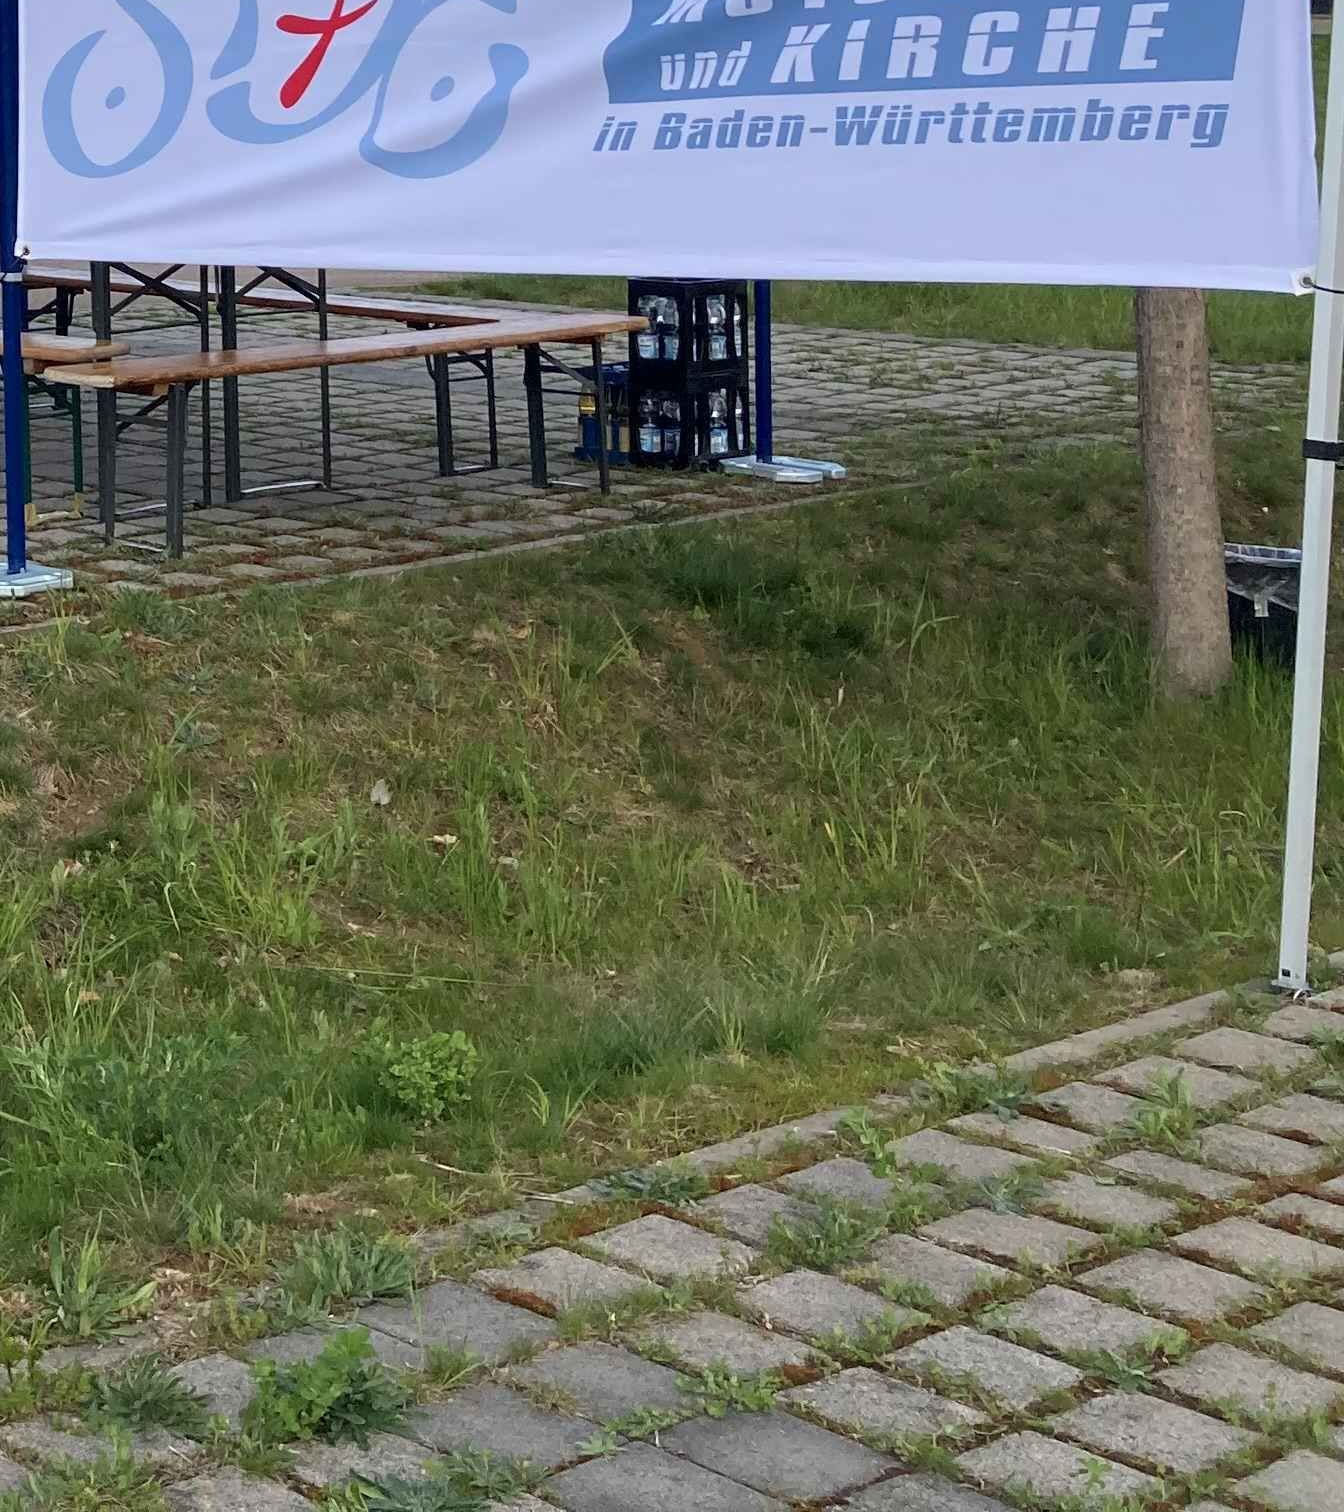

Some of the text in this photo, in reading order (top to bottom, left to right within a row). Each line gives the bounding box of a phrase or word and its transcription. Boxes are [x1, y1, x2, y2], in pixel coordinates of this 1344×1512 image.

[660, 2, 1170, 91] und KIRCHE
[592, 98, 1230, 152] in Baden-Württemberg
